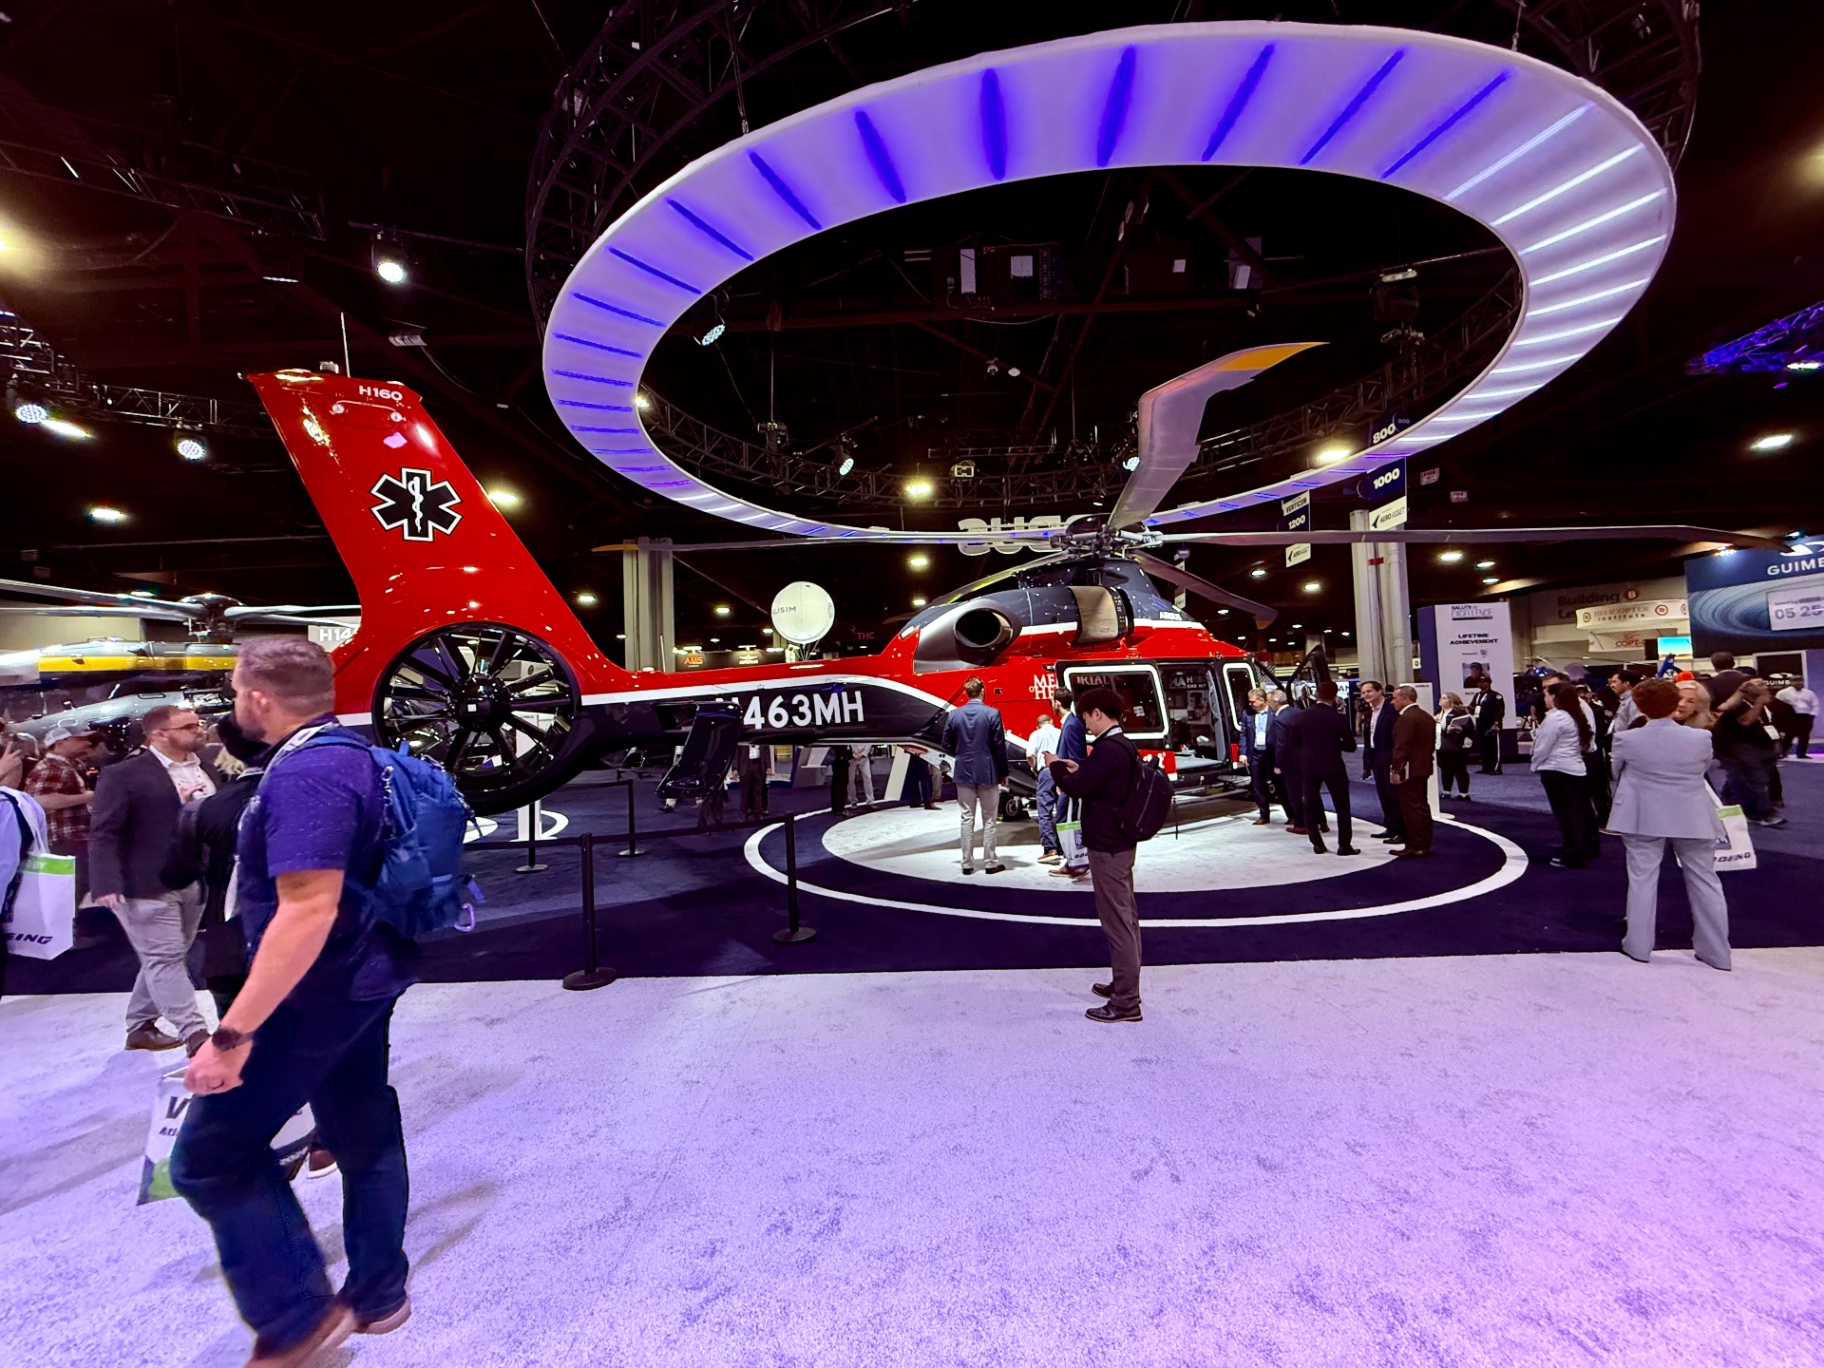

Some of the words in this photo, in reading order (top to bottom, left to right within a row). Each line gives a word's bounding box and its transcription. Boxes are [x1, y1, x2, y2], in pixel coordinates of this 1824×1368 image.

[359, 385, 403, 401] H160
[1373, 423, 1396, 444] 800
[1373, 468, 1400, 489] 1000
[1288, 515, 1306, 530] 1200
[1558, 592, 1620, 606] Building
[1628, 590, 1636, 598] B
[1451, 608, 1493, 617] EXCELLENCE
[1775, 608, 1795, 619] 05
[320, 628, 353, 641] H14
[857, 632, 875, 640] THC
[714, 690, 864, 730] 463MH
